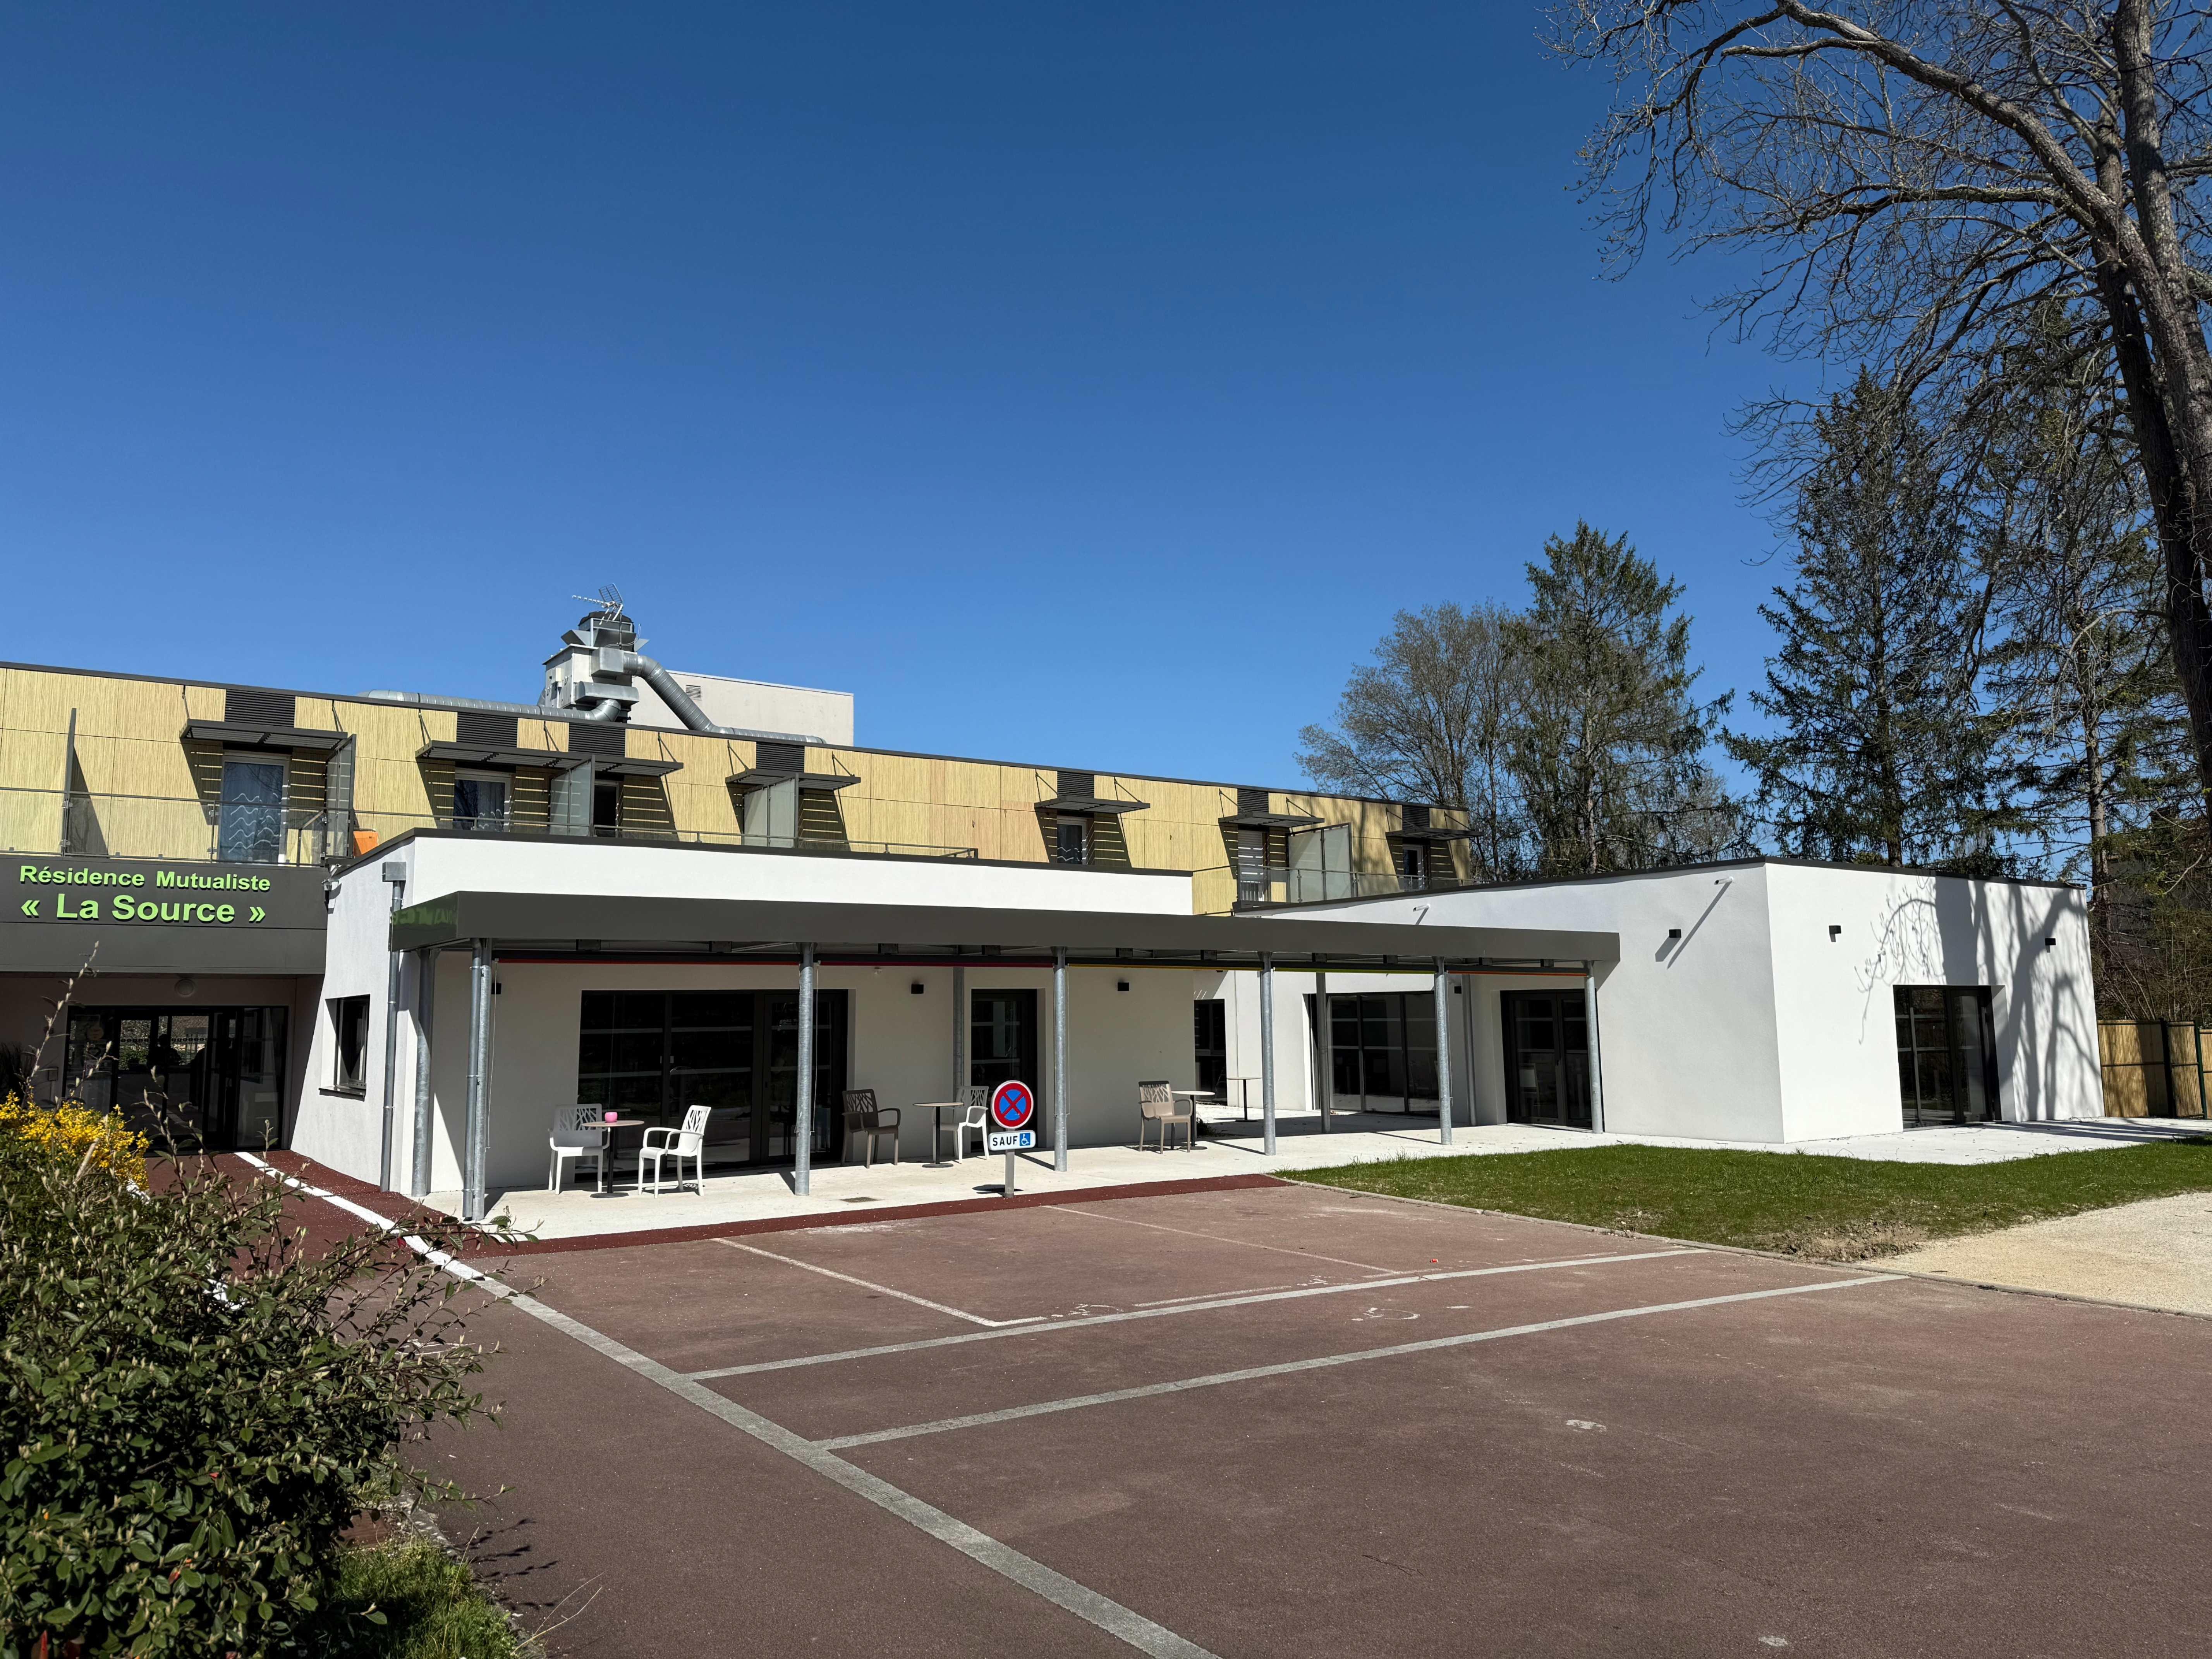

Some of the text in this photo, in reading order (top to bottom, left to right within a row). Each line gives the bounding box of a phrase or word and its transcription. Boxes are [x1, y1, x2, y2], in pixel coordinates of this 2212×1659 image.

[20, 866, 271, 891] Résidence Mutualiste
[57, 893, 99, 919] La
[112, 895, 235, 922] Source
[993, 1136, 1018, 1146] SAUF
